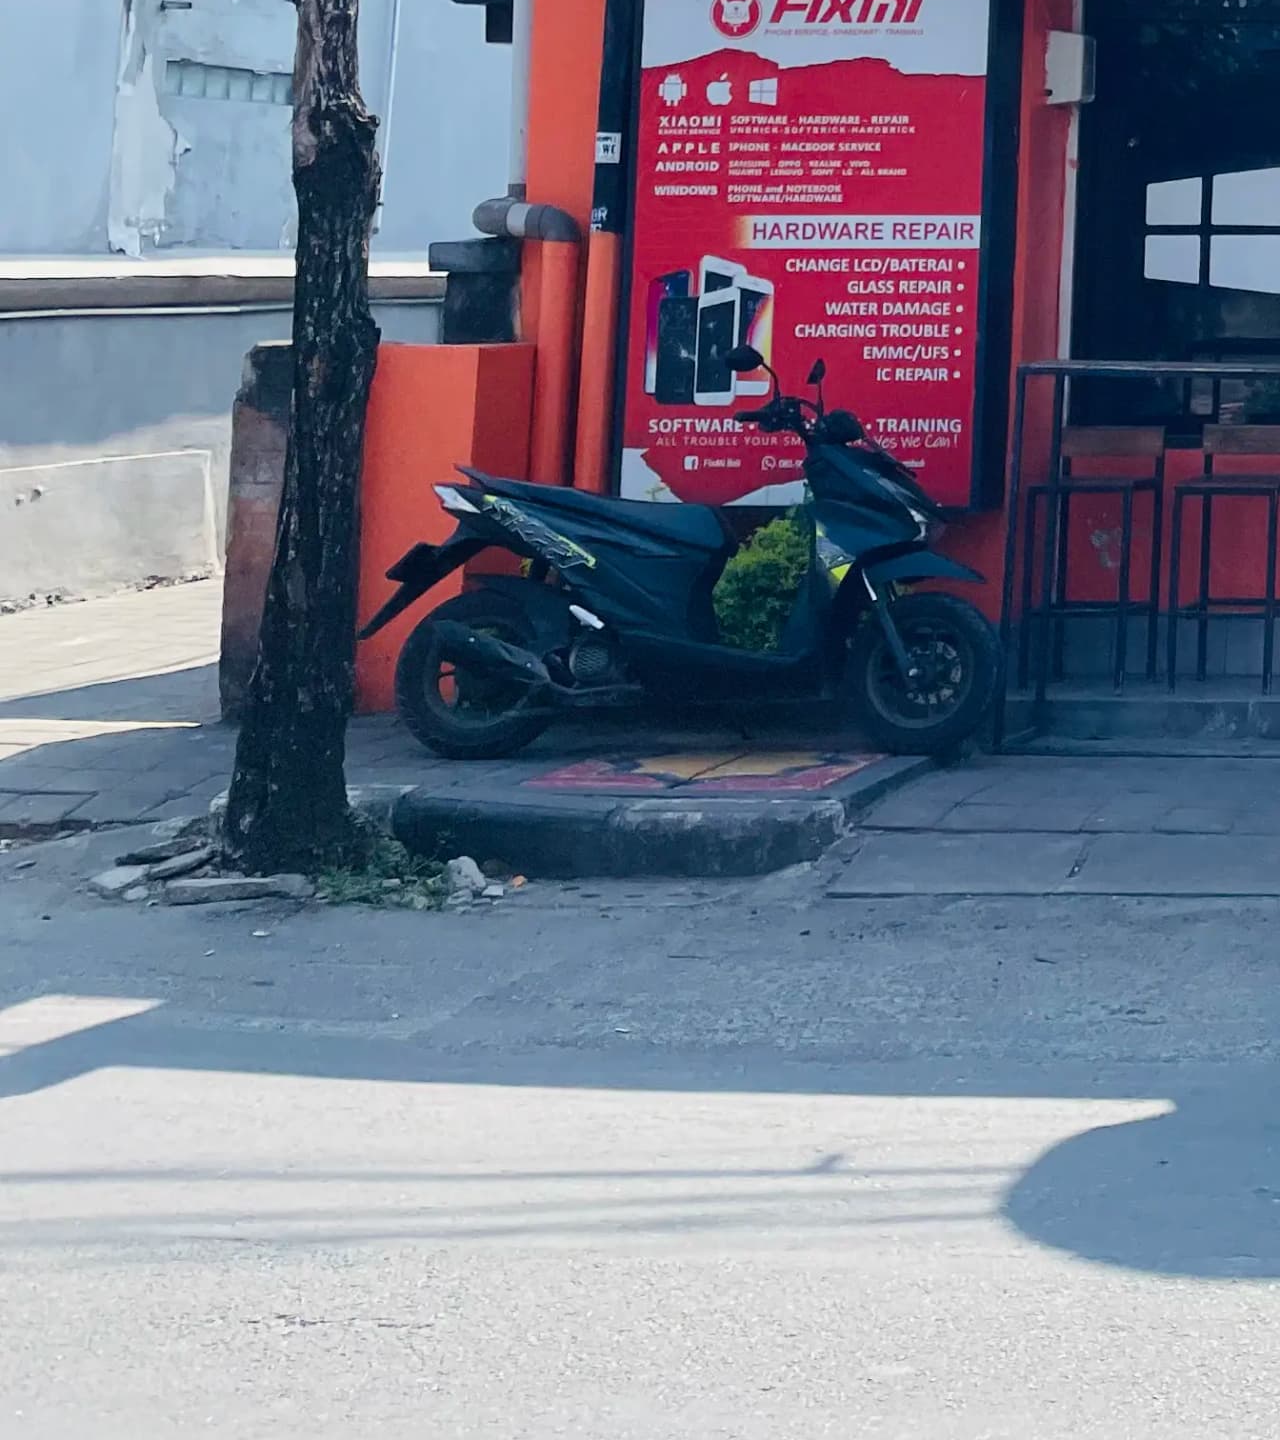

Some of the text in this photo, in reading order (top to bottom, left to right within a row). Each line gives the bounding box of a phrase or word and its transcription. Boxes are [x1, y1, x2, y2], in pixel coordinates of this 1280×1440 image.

[659, 115, 909, 127] XIAOMI SOFTWARE HARDWARE REPAIR
[657, 142, 881, 154] APPLE IPHONE MACBOOK SERVICE
[655, 160, 720, 172] ANDROID
[654, 185, 719, 196] WINDOWS
[727, 184, 763, 193] PHONE
[786, 184, 842, 193] NOTEBOOK
[752, 222, 975, 241] HARDWARE REPAIR
[785, 258, 953, 274] CHANGE LCD/BATERAI
[847, 280, 952, 294] GLASS REPAIR
[825, 302, 951, 316] WATER DAMAGE
[794, 324, 950, 338] CHARGING TROUBLE
[863, 346, 949, 362] EMMC/UFS
[876, 368, 949, 381] IC REPAIR
[648, 418, 962, 433] SOFTWARE TRAINING
[656, 436, 677, 446] ALL
[683, 436, 738, 446] TROUBLE
[744, 436, 778, 446] YOUR
